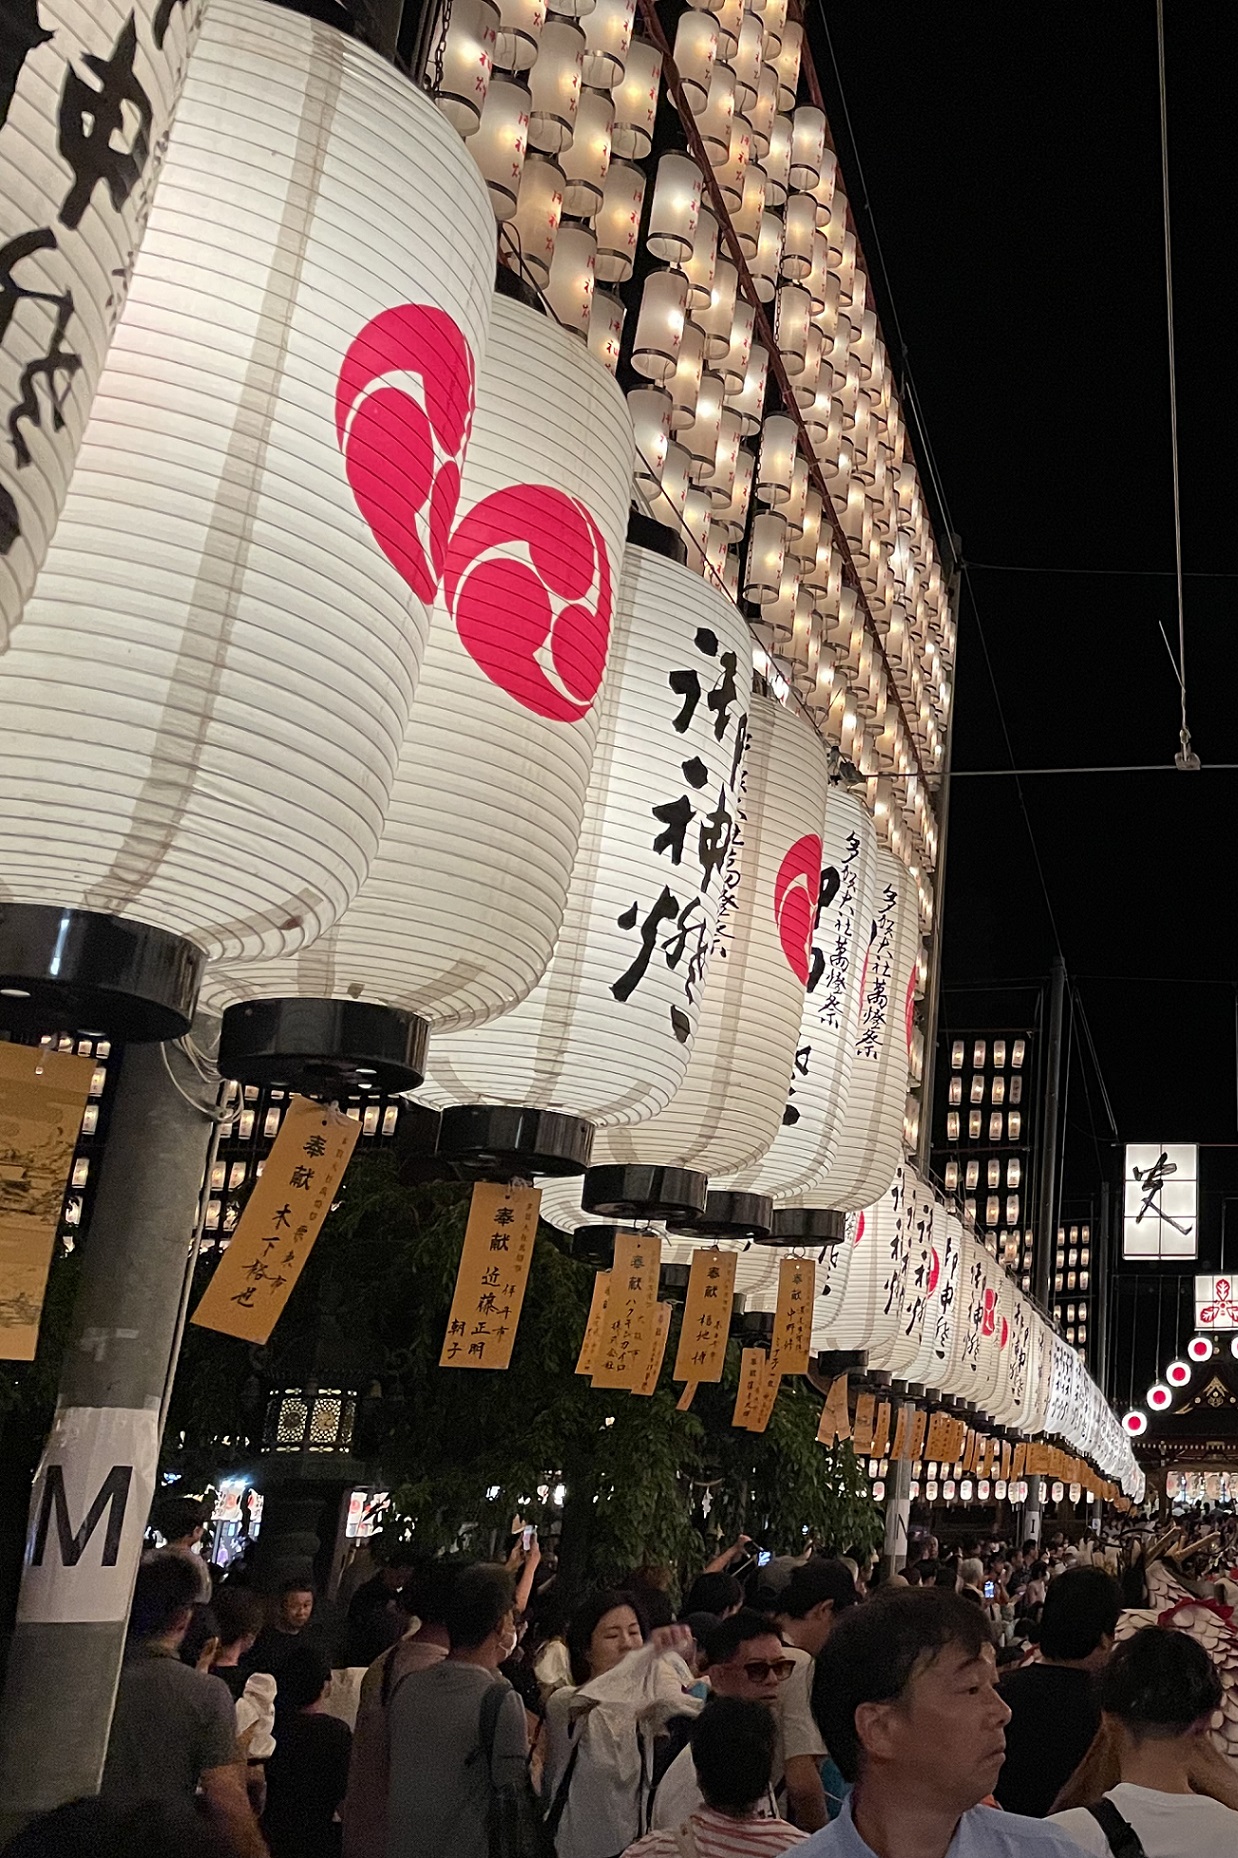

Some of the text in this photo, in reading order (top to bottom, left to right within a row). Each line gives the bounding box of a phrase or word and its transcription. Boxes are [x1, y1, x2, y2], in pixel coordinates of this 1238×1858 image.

[289, 1134, 327, 1191] 奉献
[489, 1206, 515, 1252] 奉献
[628, 1254, 646, 1291] 奉献
[704, 1266, 720, 1299] 奉献
[29, 1465, 134, 1568] M
